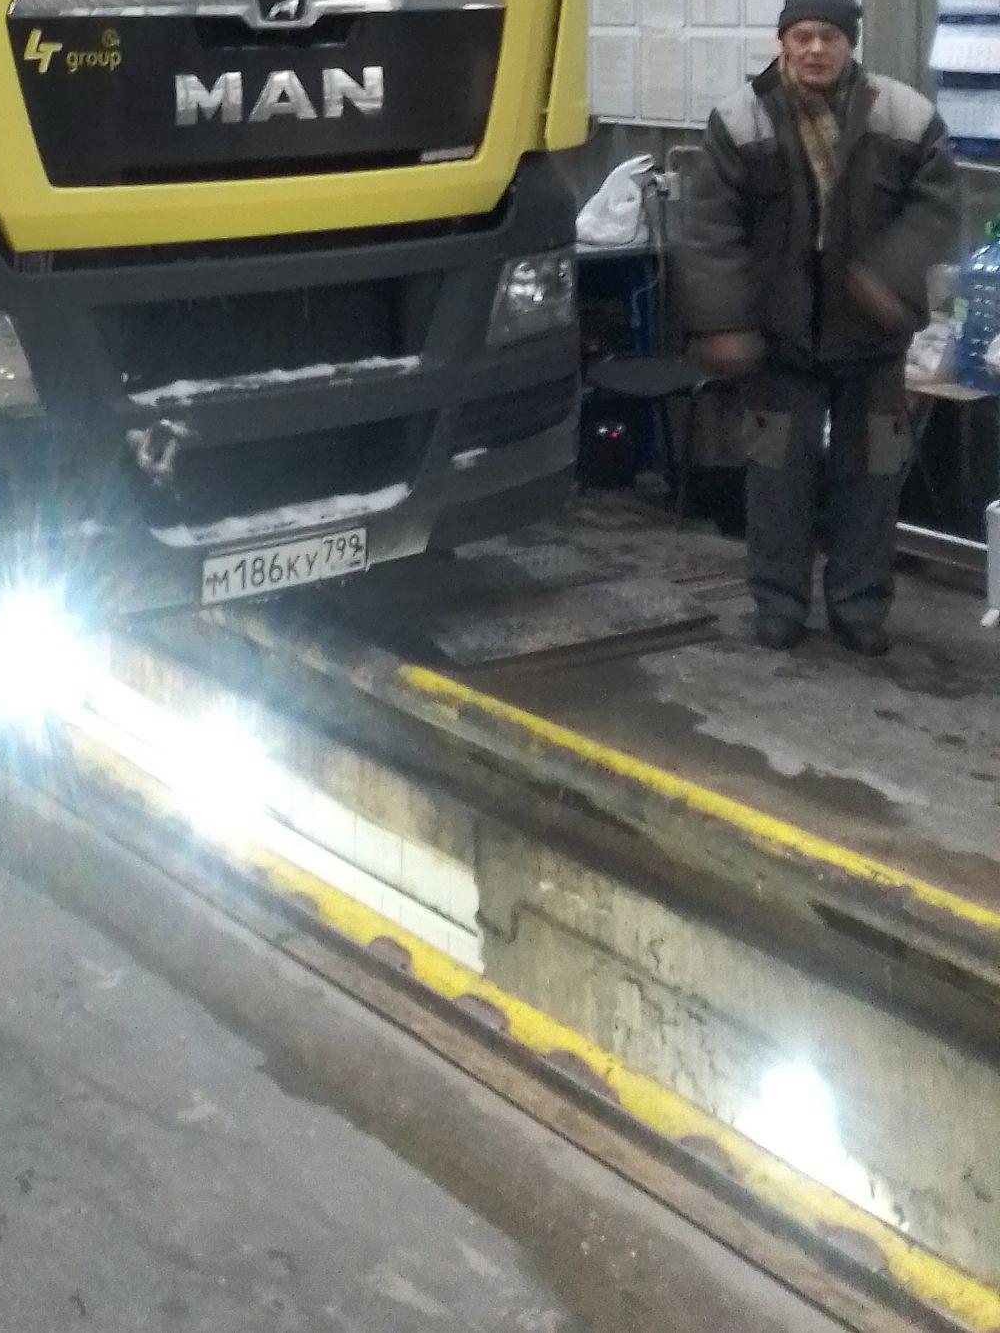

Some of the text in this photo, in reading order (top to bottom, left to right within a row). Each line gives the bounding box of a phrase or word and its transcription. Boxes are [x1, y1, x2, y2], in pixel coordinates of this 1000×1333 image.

[66, 51, 122, 73] group
[174, 65, 384, 127] MAN
[323, 533, 362, 563] 799
